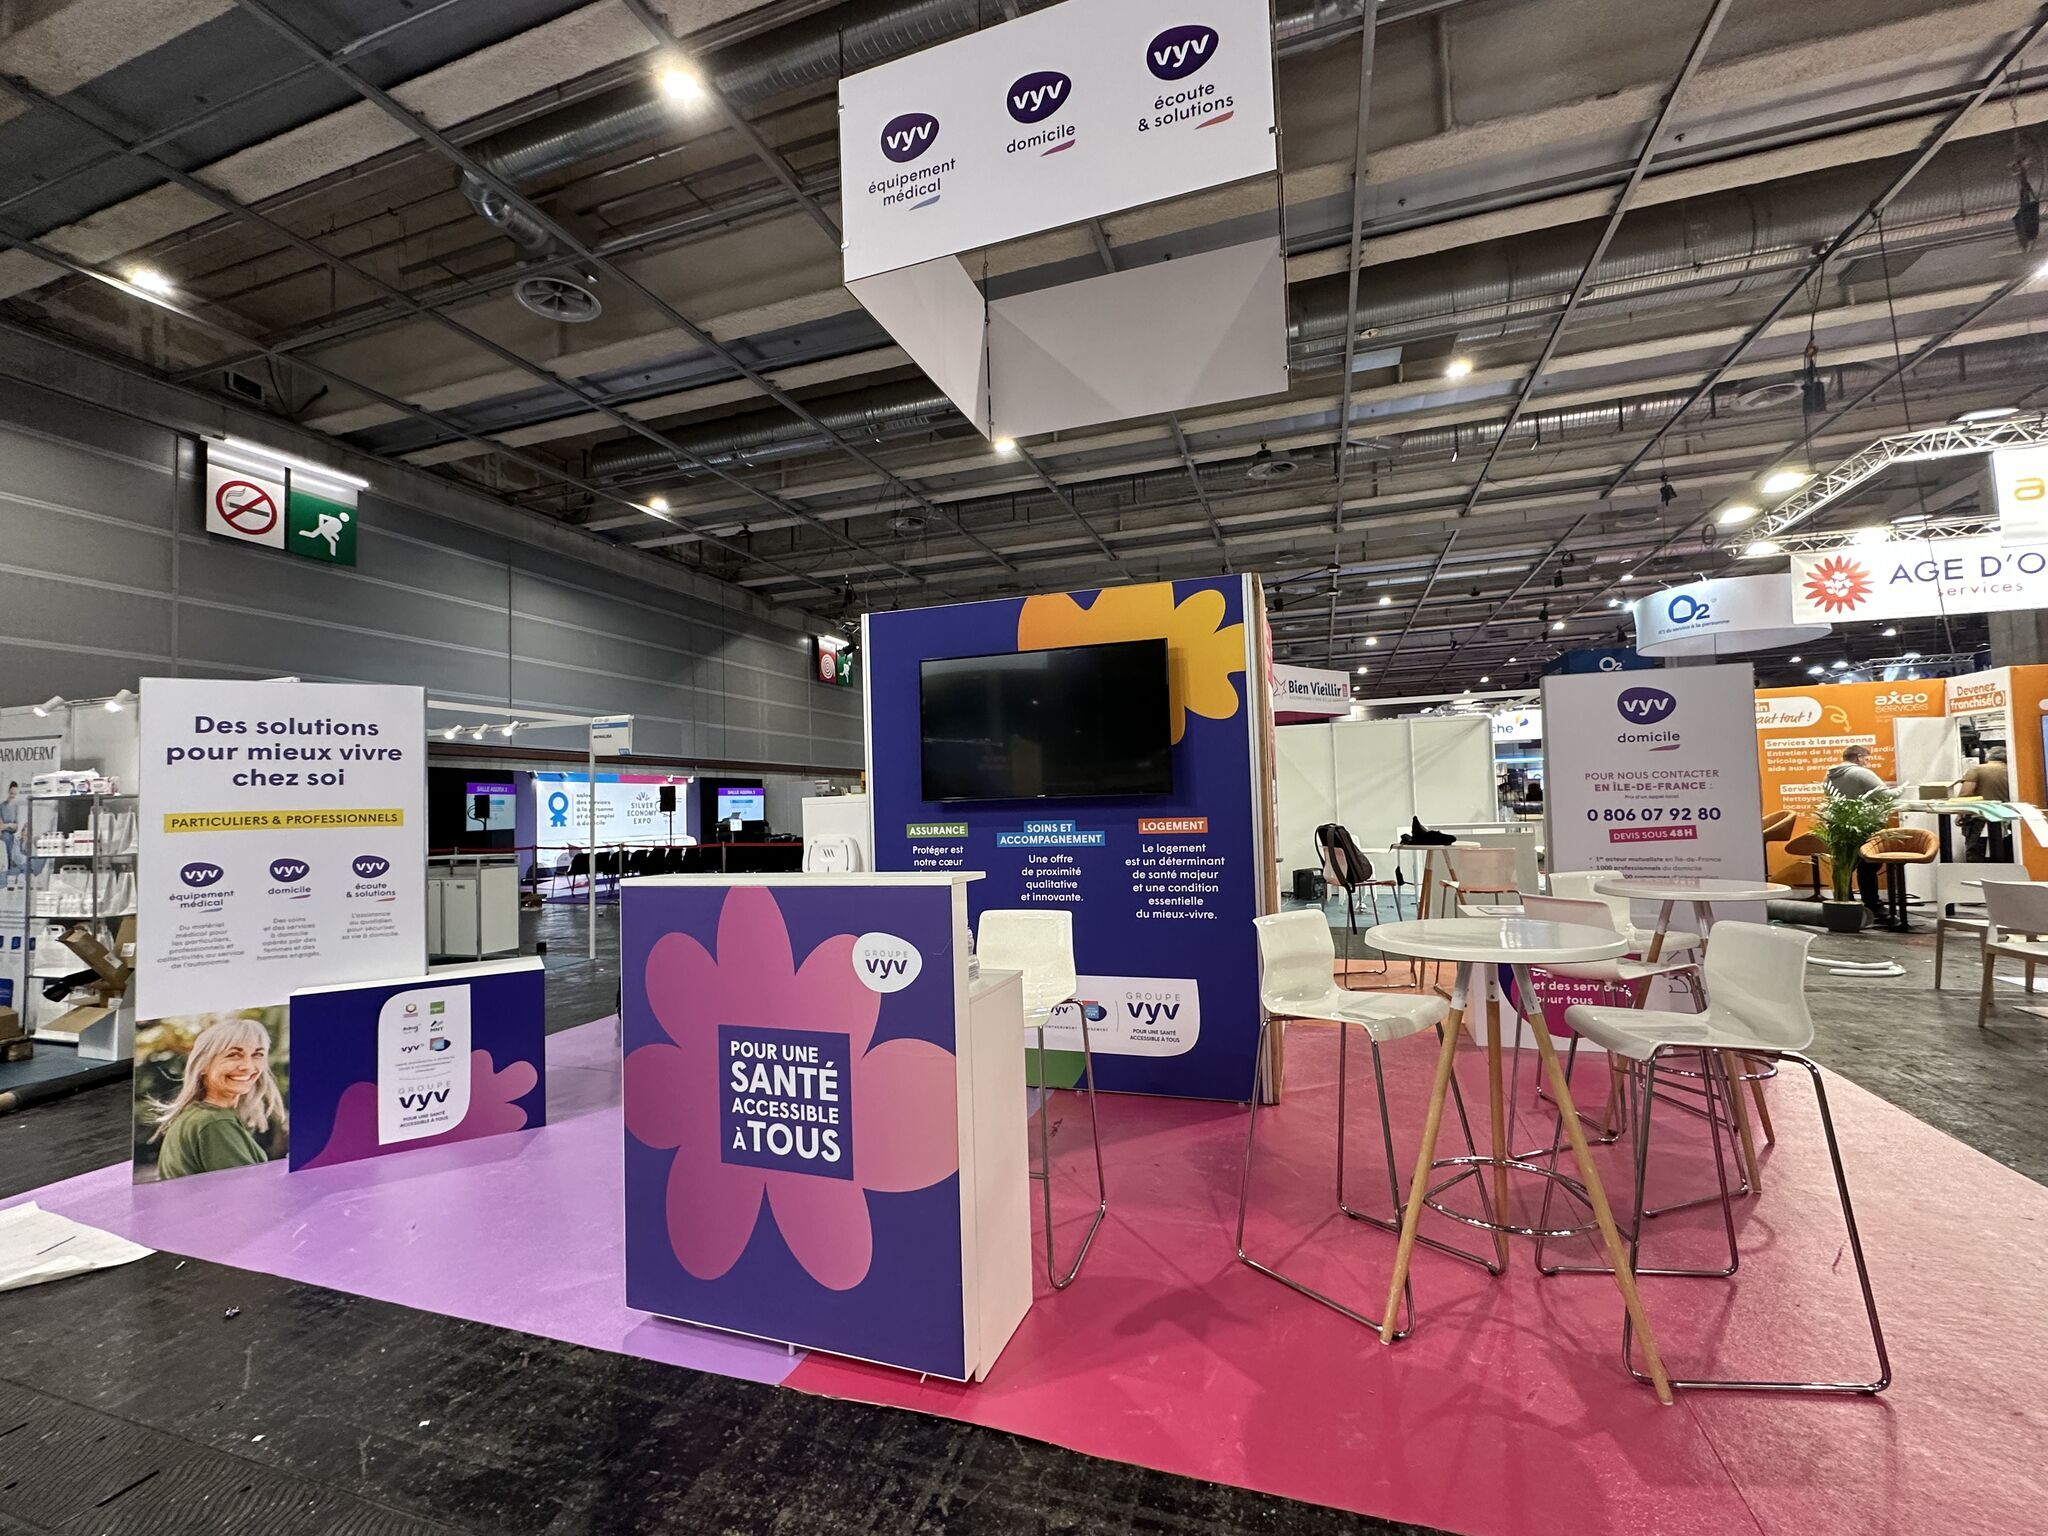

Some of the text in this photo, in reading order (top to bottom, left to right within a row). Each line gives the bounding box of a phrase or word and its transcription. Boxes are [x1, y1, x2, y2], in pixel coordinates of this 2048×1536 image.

[1153, 33, 1210, 68] vyv
[1012, 79, 1064, 112] vyv
[1153, 83, 1215, 110] écoute
[1137, 95, 1235, 132] & solutions
[886, 121, 933, 151] vyv
[1006, 125, 1076, 154] domicile
[868, 158, 956, 194] équipement
[883, 178, 941, 206] médical
[1889, 552, 2046, 585] AGE D'O
[1288, 680, 1309, 695] Bien
[1310, 682, 1342, 697] Vieillir
[1957, 682, 1996, 697] Devenez
[1874, 690, 1928, 706] axeo
[1950, 692, 2006, 711] franchisé(e)
[1623, 697, 1669, 716] vyv
[195, 715, 379, 736] Des solutions
[1617, 731, 1681, 743] domicile
[1766, 735, 1874, 747] Services la personne
[166, 743, 403, 765] pour mieux vivre
[1812, 756, 1838, 764] garde
[232, 769, 344, 787] chez soi
[1584, 769, 1719, 781] POUR NOUS CONTACTER
[1594, 781, 1706, 792] EN ÎLE-DE-FRANCE
[1587, 807, 1721, 821] 0 806 07 92 80
[172, 813, 398, 828] PARTICULIERS & PROFESSIONNELS
[1142, 821, 1205, 831] LOGEMENT
[909, 826, 965, 836] ASSURANCE
[1027, 823, 1073, 833] SOINS ET
[1613, 828, 1693, 840] DEVIS SOUS 48H
[1000, 834, 1102, 845] ACCOMPAGNEMENT
[912, 845, 964, 855] Protéger est
[1142, 844, 1206, 854] Le logement
[914, 858, 937, 866] notre
[1028, 854, 1074, 864] Une offre
[1125, 857, 1141, 866] est
[1161, 856, 1226, 866] déterminant
[273, 864, 305, 877] vyv
[356, 860, 385, 873] vyv
[1021, 867, 1082, 878] de proximité
[185, 869, 218, 881] vyv
[1132, 869, 1219, 881] de santé majeur
[268, 885, 312, 895] domicile
[355, 882, 387, 890] écoute
[1025, 880, 1078, 889] qualitative
[1132, 884, 1143, 892] et
[1167, 883, 1219, 892] condition
[169, 889, 234, 901] équipement
[355, 889, 396, 898] solutions
[1020, 892, 1084, 902] et innovante.
[180, 899, 224, 909] médical
[1148, 896, 1204, 906] essentielle
[1136, 909, 1218, 920] du mieux-vivre.
[864, 950, 909, 958] GROUPE
[865, 958, 908, 979] vyv
[1533, 981, 1570, 991] et des
[1125, 992, 1180, 1001] GROUPE
[1567, 996, 1593, 1004] tous
[1127, 1002, 1180, 1025] vyv
[730, 1040, 818, 1063] POUR UNE
[398, 1080, 452, 1094] GROUPE
[730, 1061, 838, 1102] SANTÉ
[399, 1088, 451, 1112] vyv
[732, 1097, 839, 1125] ACCESSIBLE
[732, 1120, 841, 1163] À TOUS
